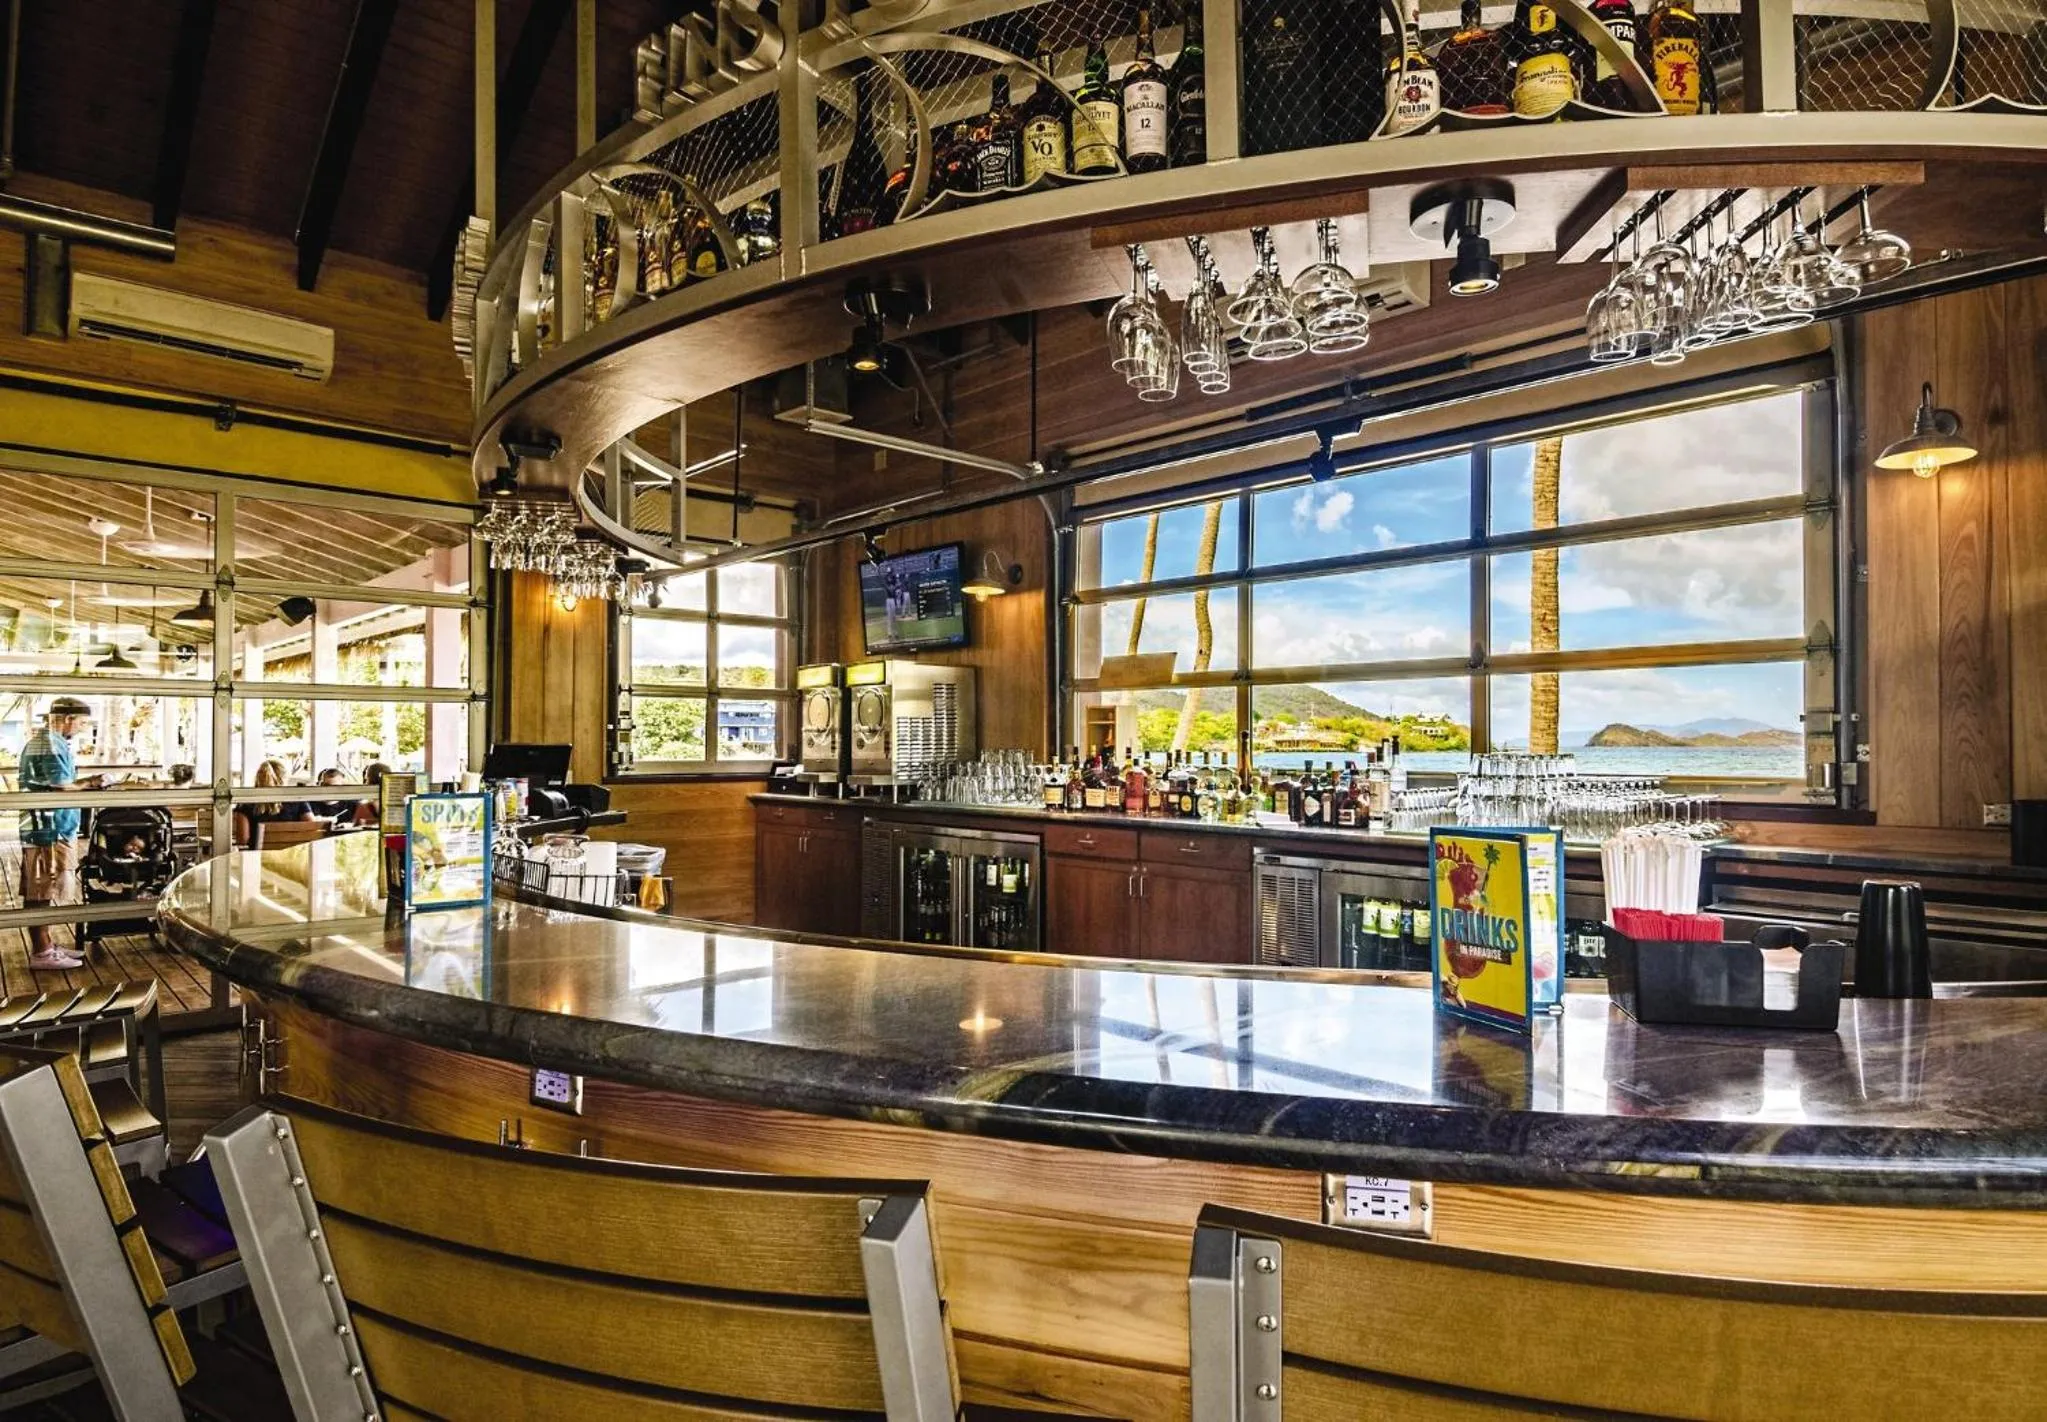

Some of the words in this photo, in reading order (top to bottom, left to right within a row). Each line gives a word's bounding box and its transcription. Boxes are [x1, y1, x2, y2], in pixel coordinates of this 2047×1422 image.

[1655, 43, 1699, 61] FIREBALL
[1126, 102, 1165, 113] MACALLAN
[1398, 103, 1431, 114] BOURBON
[1140, 117, 1151, 129] 12
[1440, 906, 1519, 953] DRINKS
[1469, 945, 1503, 960] PARADISE
